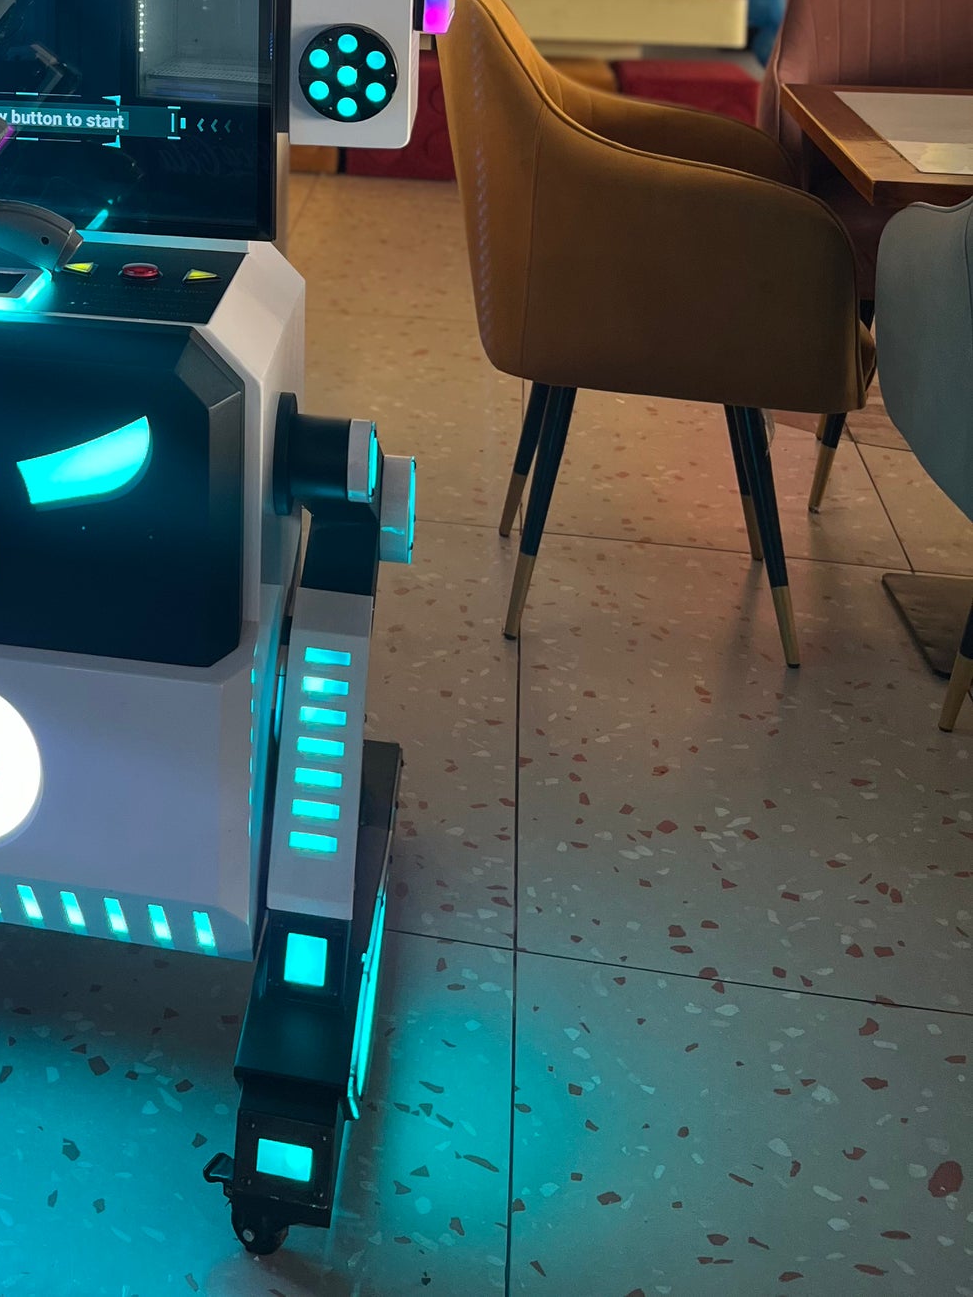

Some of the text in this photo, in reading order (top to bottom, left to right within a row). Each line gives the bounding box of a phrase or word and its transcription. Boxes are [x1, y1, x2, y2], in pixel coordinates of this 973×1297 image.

[11, 109, 63, 126] button
[66, 113, 83, 127] to
[86, 114, 125, 129] start
